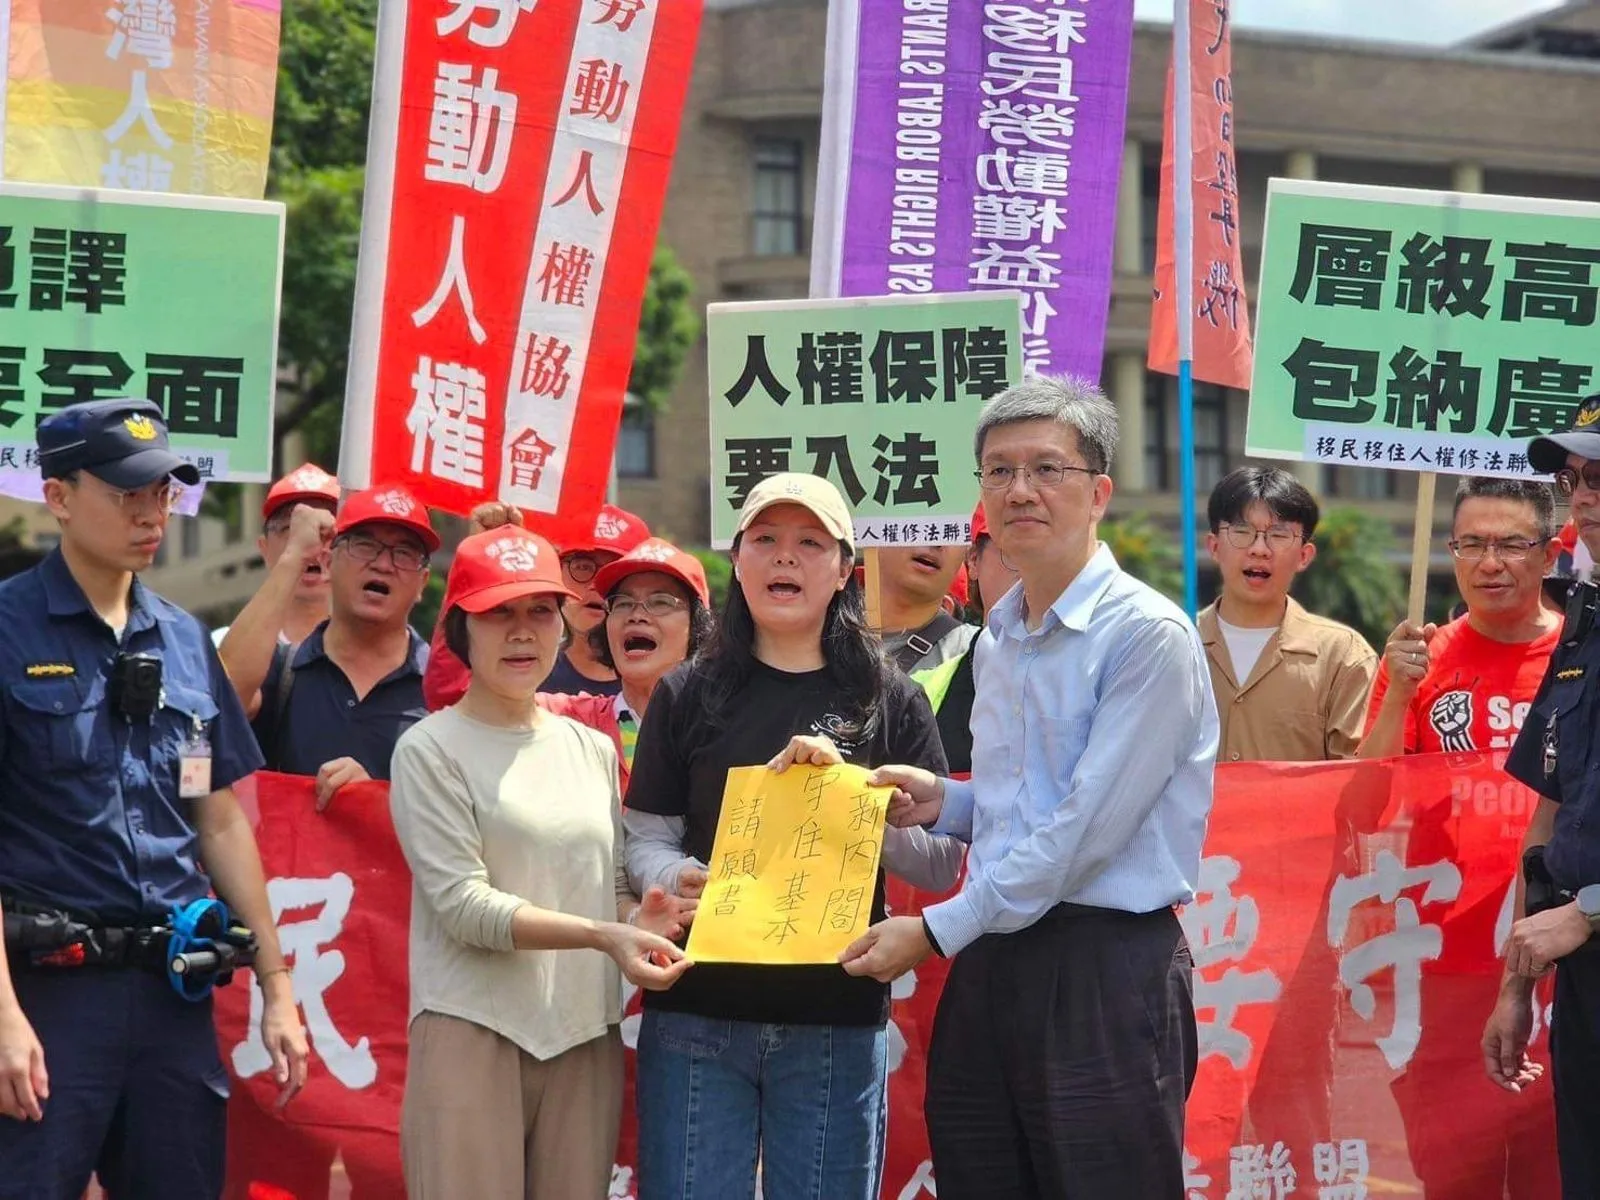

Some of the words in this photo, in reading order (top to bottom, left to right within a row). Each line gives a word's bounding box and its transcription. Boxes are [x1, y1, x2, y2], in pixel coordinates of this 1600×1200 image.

[1289, 222, 1600, 327] 層級高
[724, 326, 1009, 408] 人權保障
[1281, 337, 1593, 437] 包納廣
[725, 432, 941, 510] 要入法
[1316, 436, 1550, 476] 移民移住人權修法聯
[852, 521, 971, 543] 人權修法聯
[713, 798, 765, 916] 請願書
[762, 772, 840, 944] 守住基本
